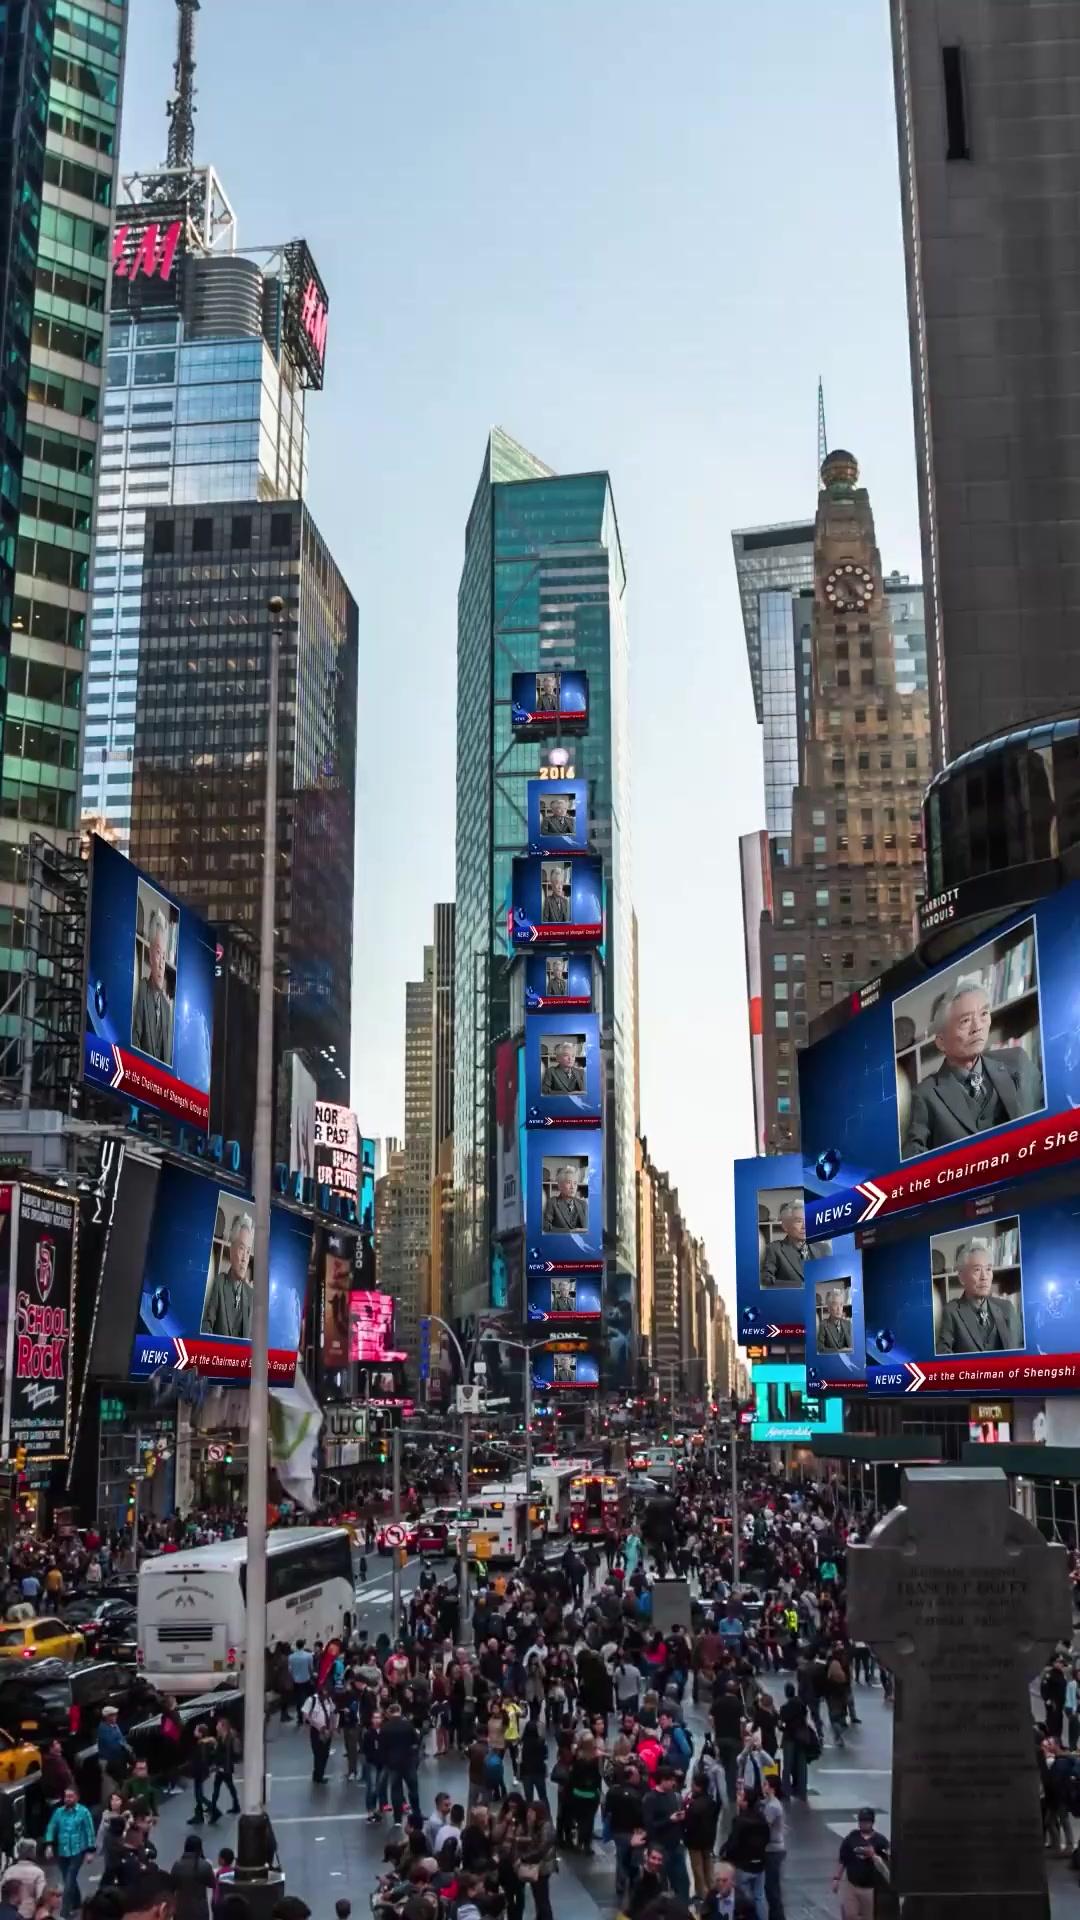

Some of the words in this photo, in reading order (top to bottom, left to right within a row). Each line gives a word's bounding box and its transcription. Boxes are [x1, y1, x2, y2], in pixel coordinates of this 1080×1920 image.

[89, 1050, 110, 1072] NEWS
[131, 1072, 140, 1085] the
[141, 1076, 163, 1098] Chairman
[326, 1127, 348, 1145] PAST
[891, 1187, 904, 1199] at
[910, 1179, 931, 1193] the
[937, 1152, 1010, 1184] Chairman
[1018, 1141, 1037, 1158] of
[815, 1202, 852, 1226] NEWS
[141, 1349, 169, 1364] NEWS
[189, 1355, 198, 1364] at
[200, 1355, 210, 1365] the
[211, 1355, 240, 1367] Chairman
[241, 1357, 248, 1367] of
[272, 1360, 288, 1371] Group
[928, 1372, 938, 1381] at
[941, 1371, 955, 1380] the
[958, 1368, 1004, 1380] Chairman
[1008, 1368, 1020, 1378] of
[1023, 1365, 1076, 1379] Shengshi
[875, 1374, 903, 1385] NEWS
